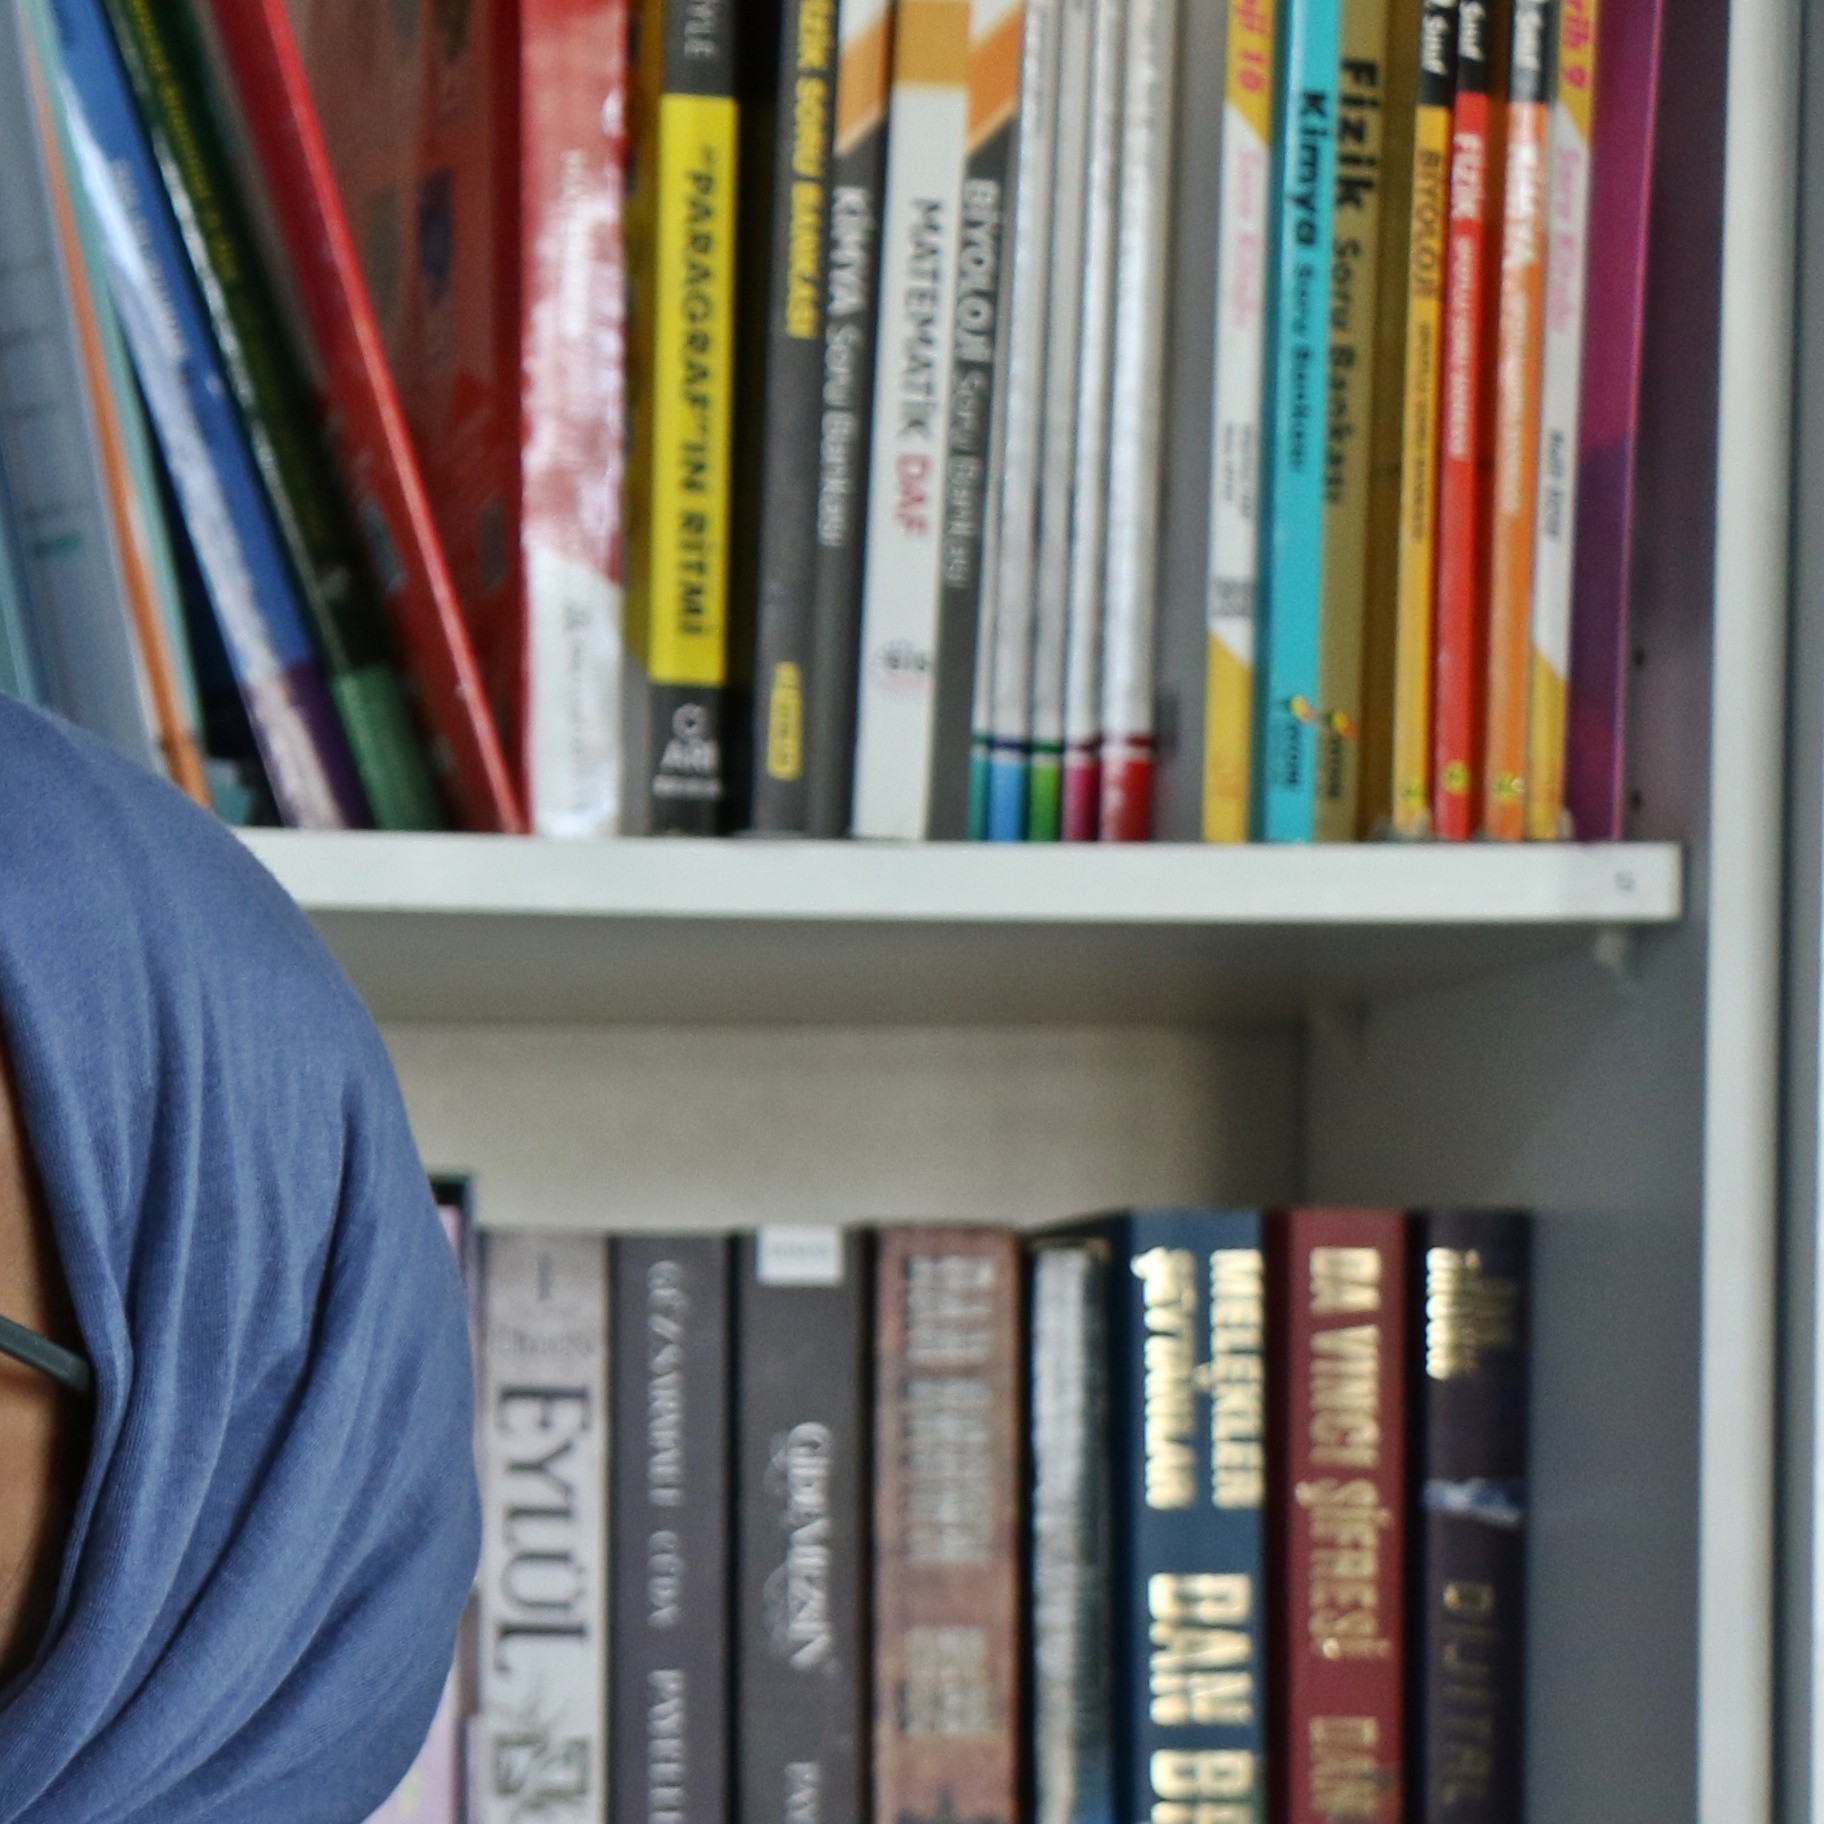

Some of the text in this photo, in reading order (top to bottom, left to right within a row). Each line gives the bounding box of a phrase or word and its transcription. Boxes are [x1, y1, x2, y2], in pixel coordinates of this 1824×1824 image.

[792, 76, 826, 177] SORU
[1288, 91, 1329, 247] Kimya
[1449, 132, 1486, 221] FİZİK
[785, 180, 822, 340] BANKASI
[954, 178, 1005, 364] BİYOLOJİ
[1324, 59, 1381, 504] Fizik Soru Bankası
[1412, 150, 1443, 300] BİYOLOJİ
[818, 185, 874, 546] KİMYA Soru Bankası
[898, 198, 945, 441] MATEMATİK
[950, 369, 986, 450] Soru
[678, 511, 716, 635] RİTMİ
[1211, 1249, 1265, 1510] MELEKLER
[1294, 1247, 1395, 1660] DA VINCI ŞİFRESİ
[492, 1383, 593, 1678] EYLÜL
[1148, 1574, 1255, 1725] DAN
[1307, 1716, 1380, 1815] DAN
